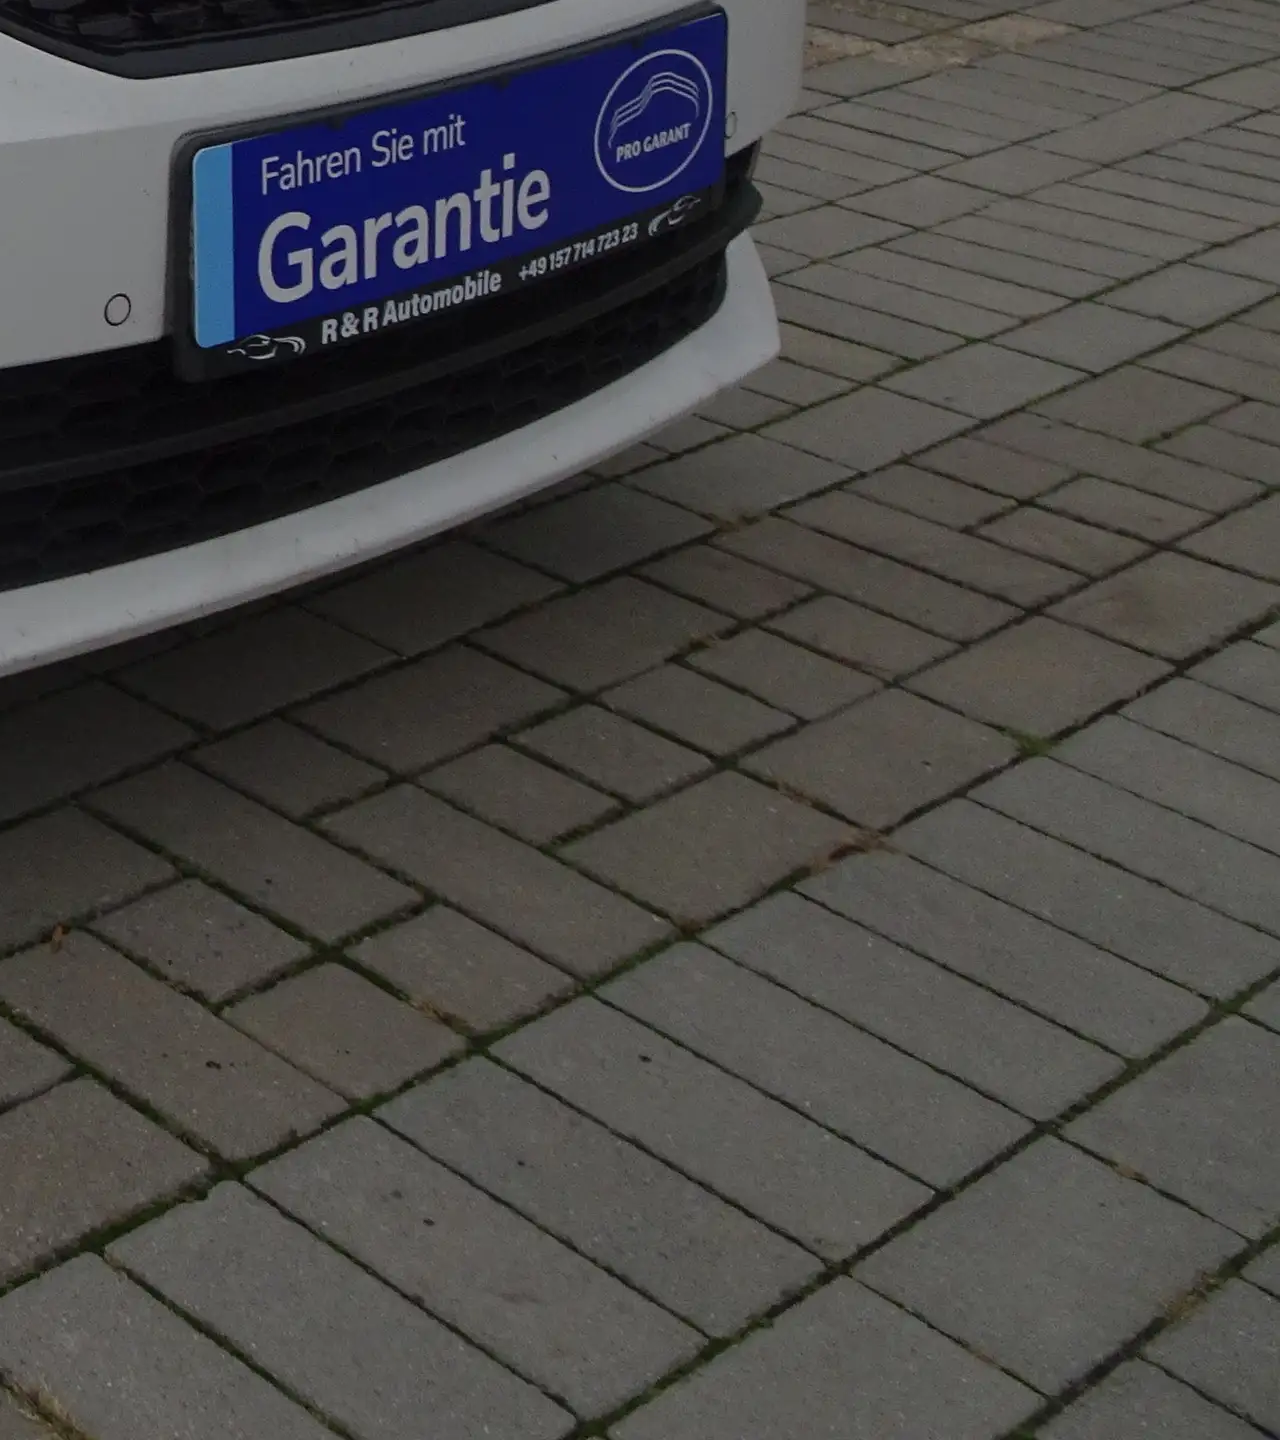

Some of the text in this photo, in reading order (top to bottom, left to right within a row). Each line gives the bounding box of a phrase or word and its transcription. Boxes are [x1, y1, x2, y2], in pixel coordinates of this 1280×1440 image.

[261, 113, 466, 195] Fahren Sie mit
[615, 122, 692, 162] PRO GARANT
[258, 153, 551, 303] Garantie
[518, 222, 638, 281] +49 157 714 723 23
[321, 268, 502, 345] R & R Automobile
